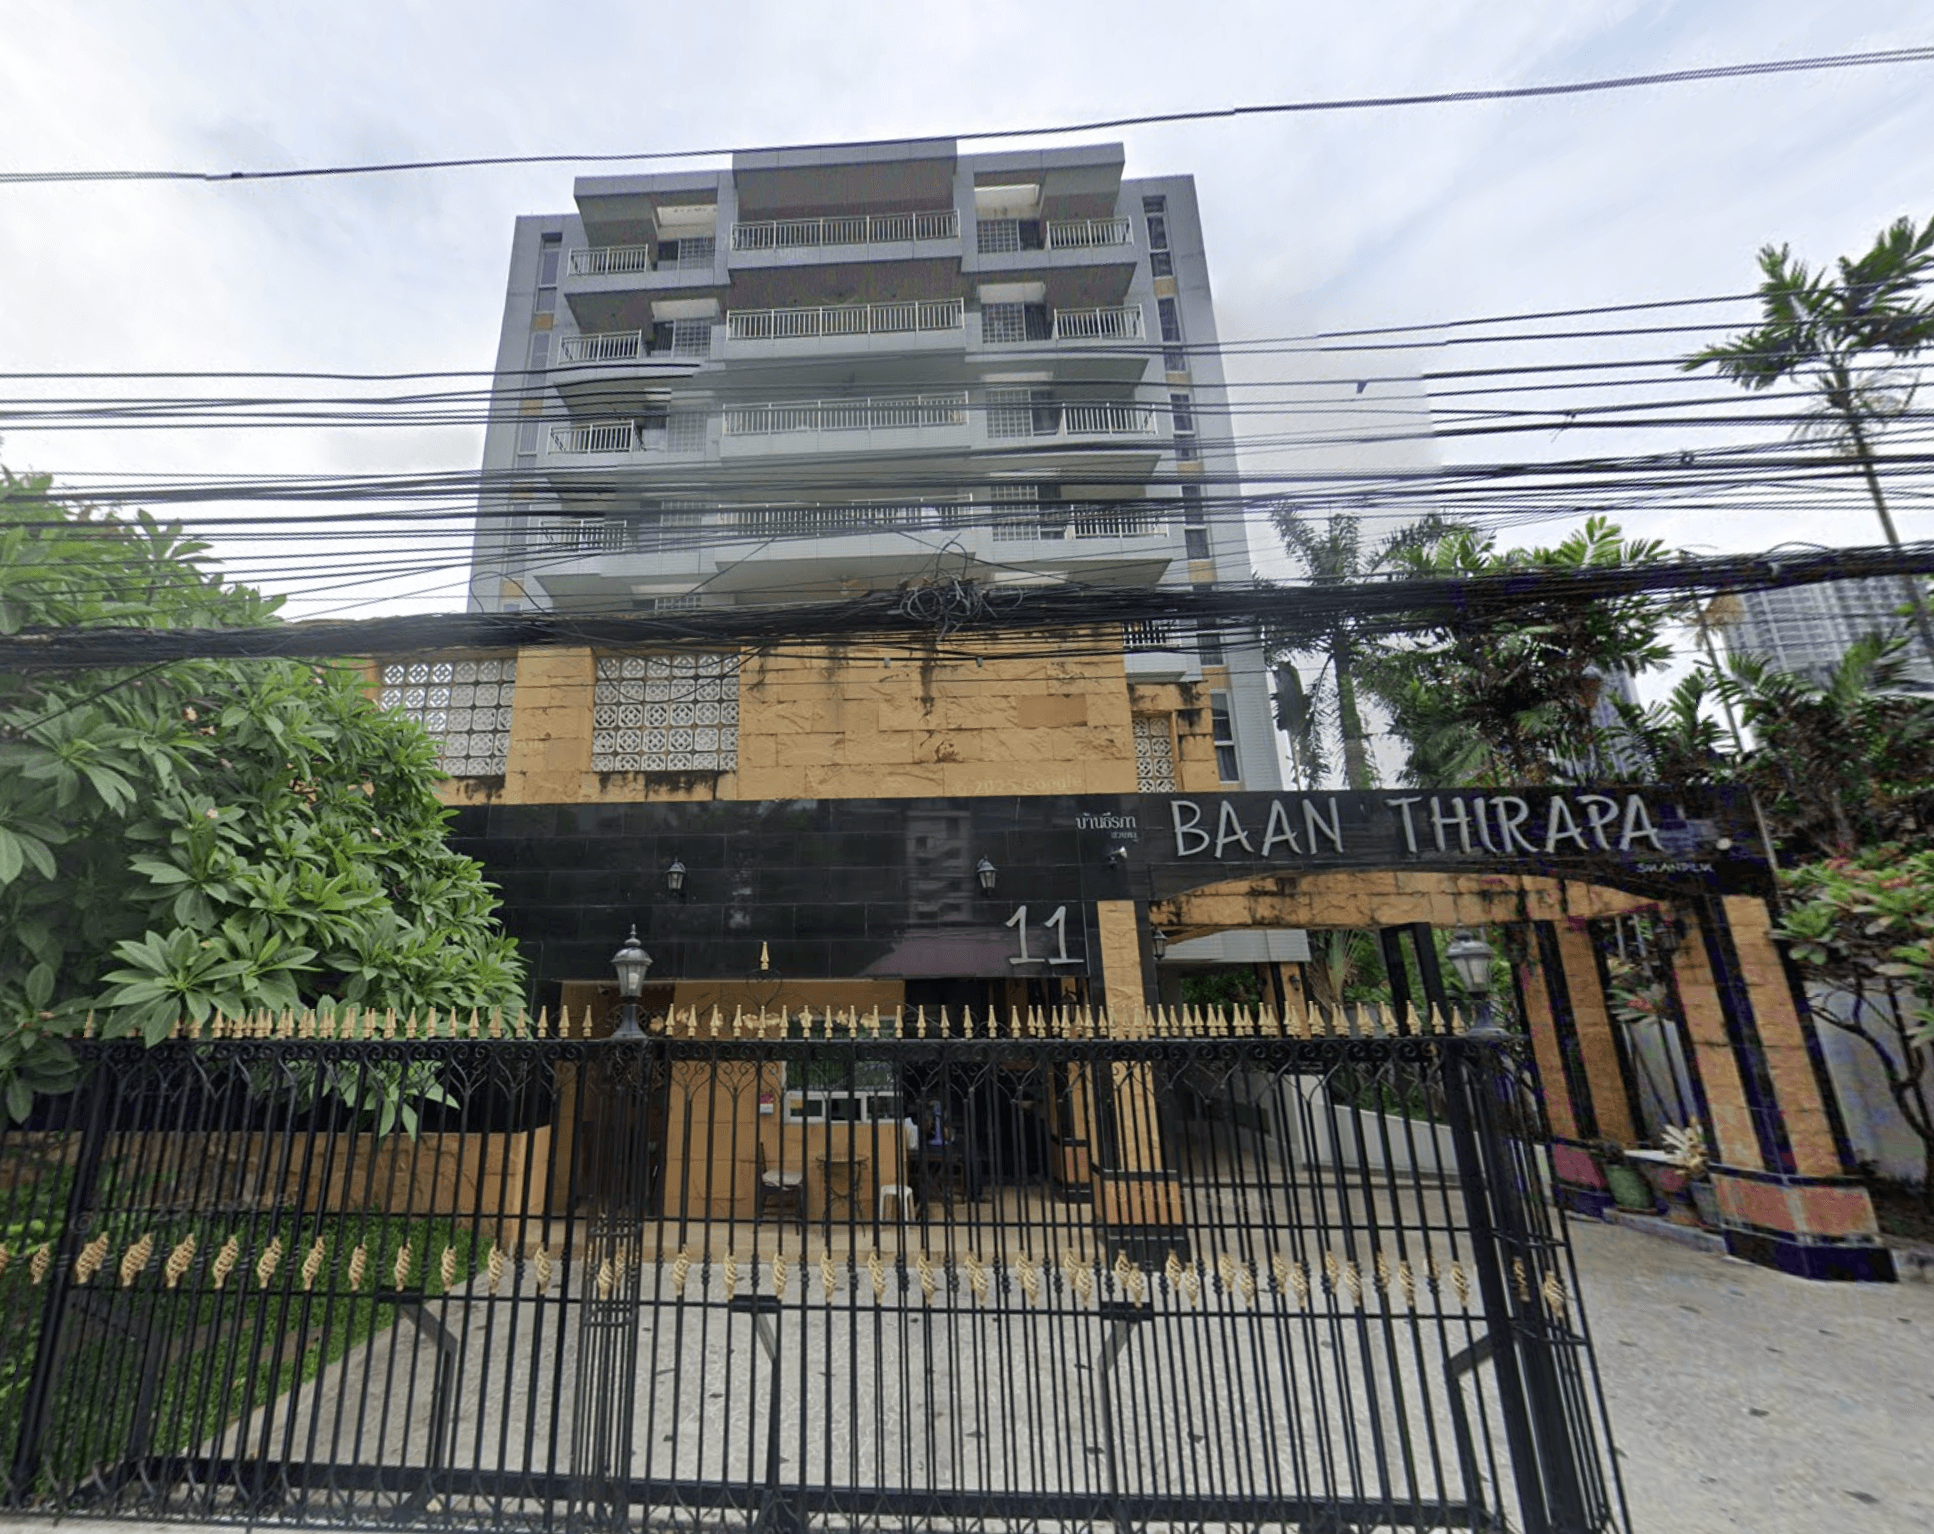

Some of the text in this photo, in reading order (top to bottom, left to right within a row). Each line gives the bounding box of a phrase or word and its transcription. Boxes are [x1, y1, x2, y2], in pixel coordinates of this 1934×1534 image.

[1171, 794, 1664, 858] BAAN THIRAPA
[1005, 904, 1085, 965] 11
